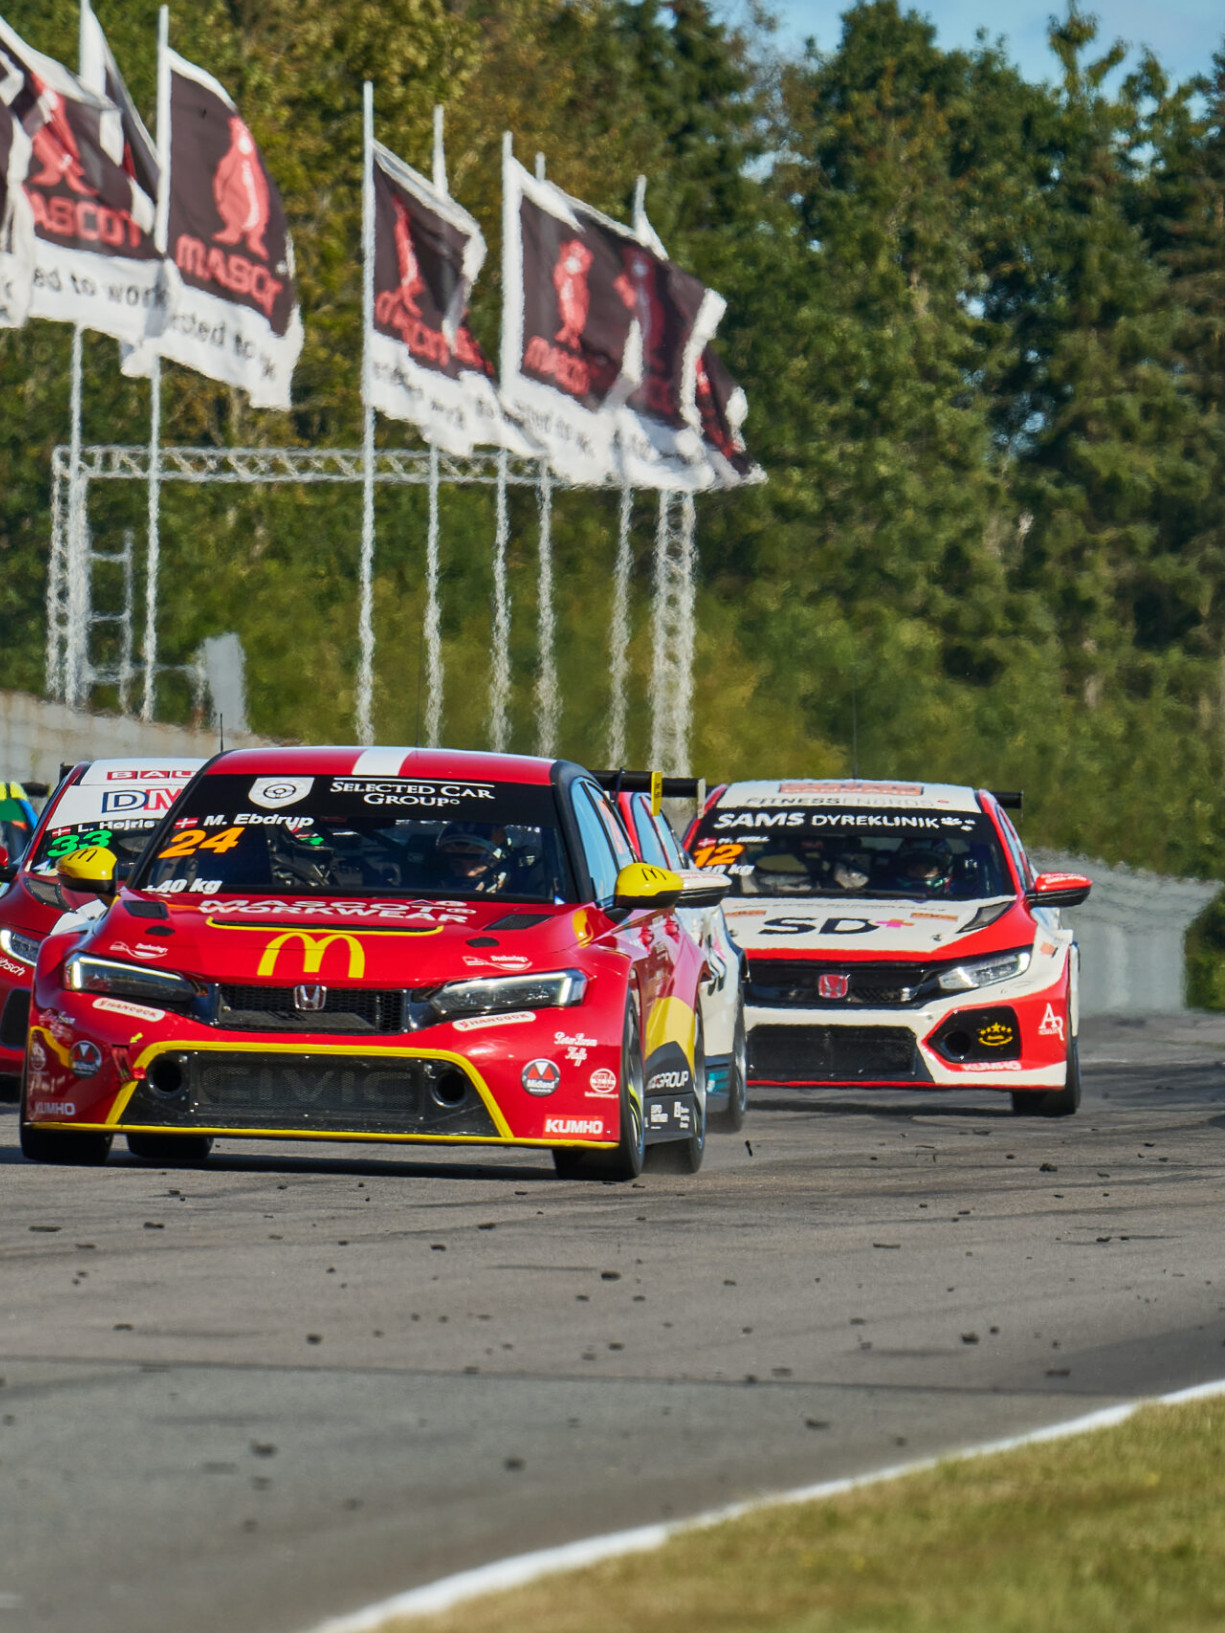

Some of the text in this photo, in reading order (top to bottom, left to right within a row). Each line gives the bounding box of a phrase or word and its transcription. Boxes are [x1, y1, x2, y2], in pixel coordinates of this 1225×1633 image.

[23, 186, 141, 247] ASCOT
[175, 233, 283, 318] MASOT
[330, 781, 496, 800] SELECTED CAR
[363, 793, 449, 807] GROUP
[203, 813, 315, 829] M. Ebdrup
[714, 812, 940, 829] SAMS DYREKLINIK
[47, 830, 114, 858] 33
[158, 826, 246, 859] 24
[693, 843, 746, 868] 12
[188, 878, 224, 895] kg
[198, 905, 469, 923] WORKWEAR
[200, 1065, 413, 1102] CIVIC
[35, 1101, 75, 1116] KUMHO
[544, 1118, 603, 1134] KUMHO
